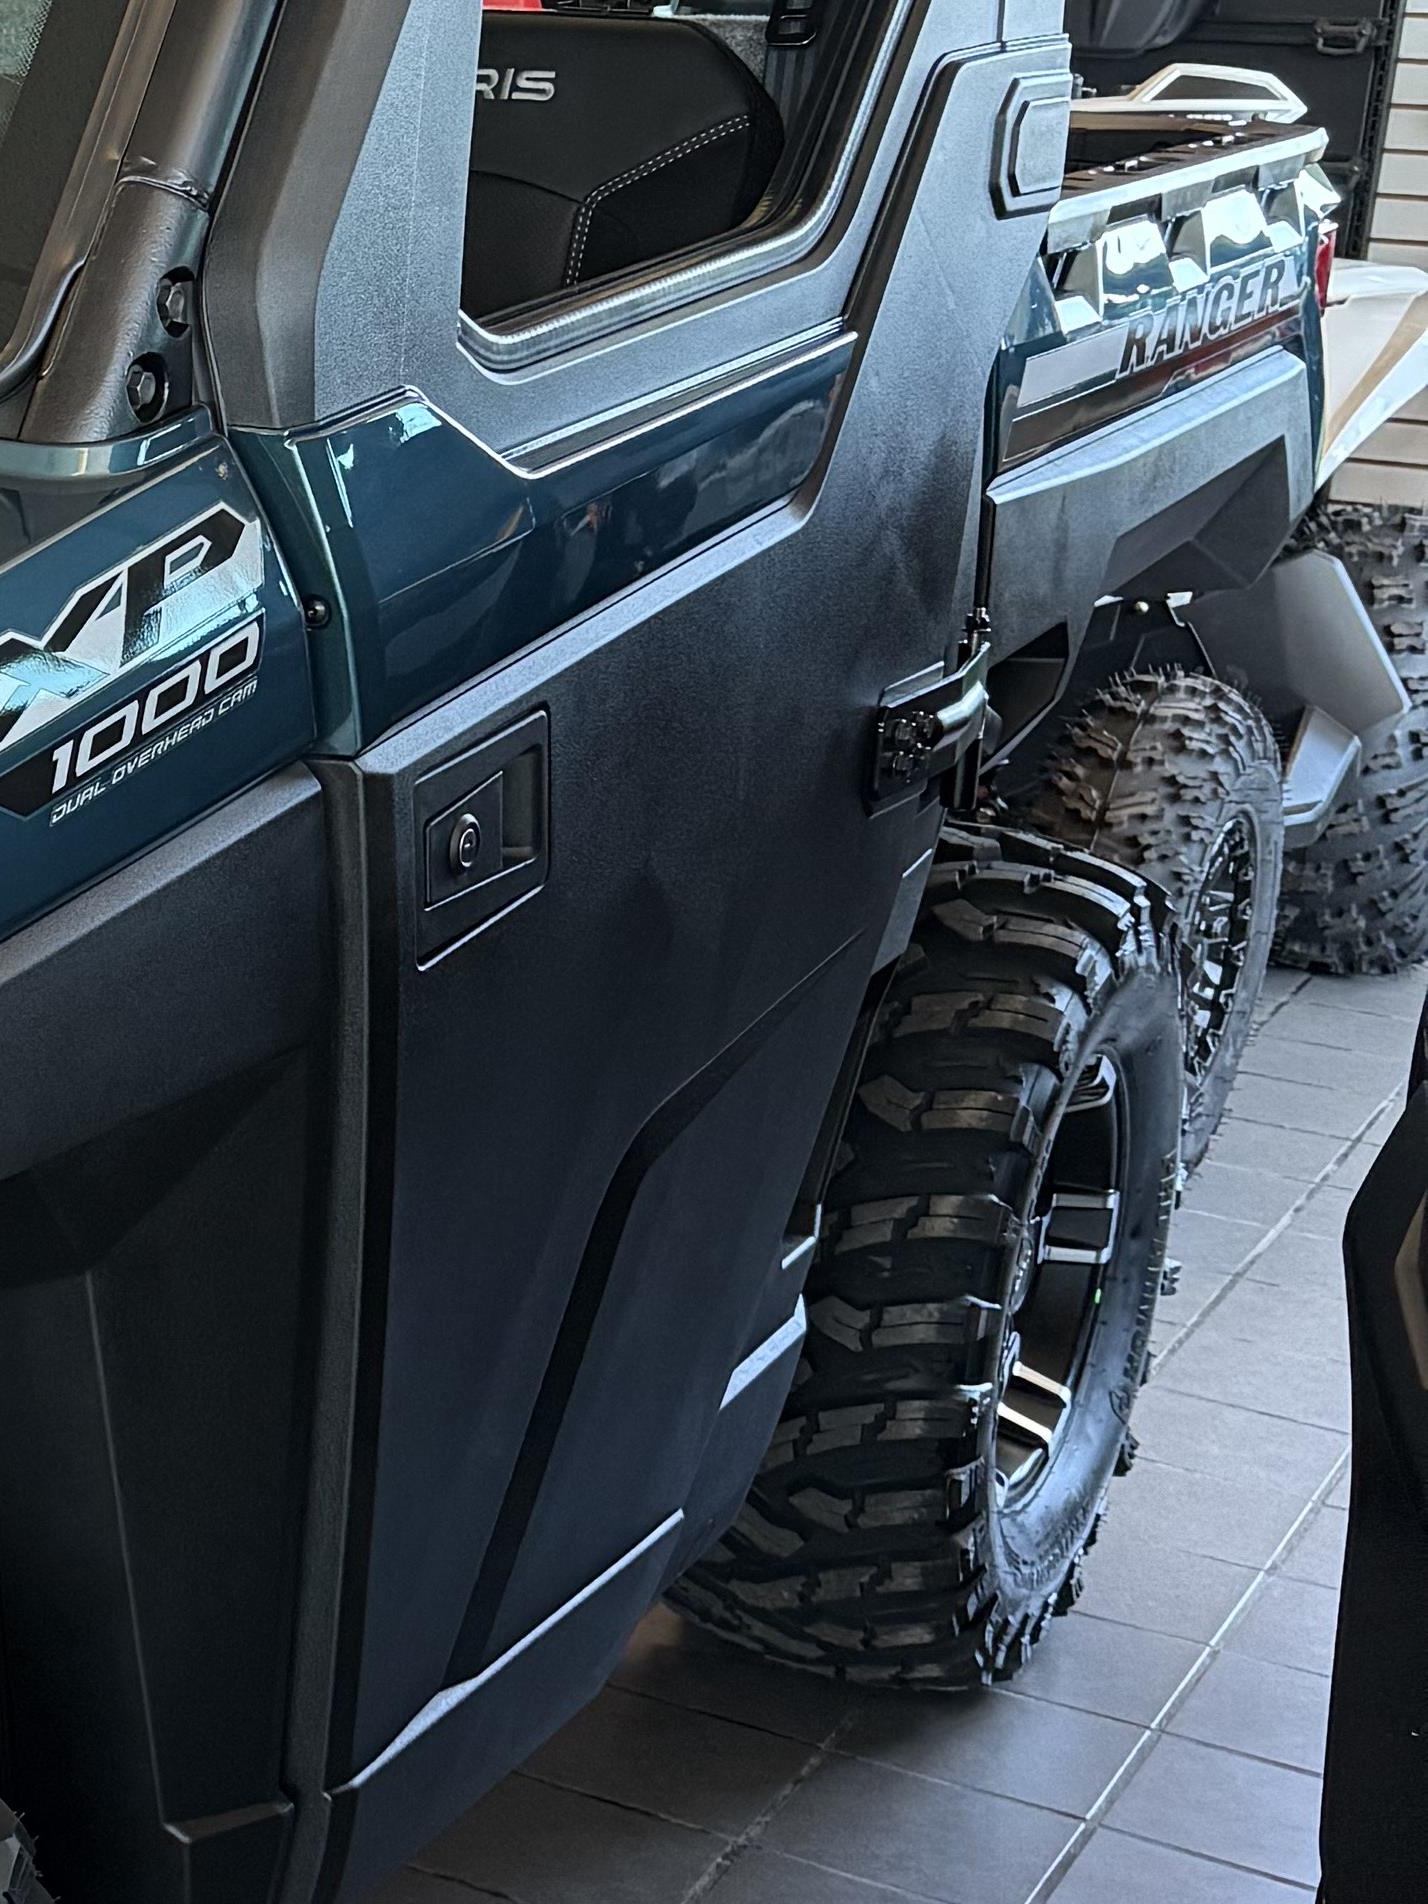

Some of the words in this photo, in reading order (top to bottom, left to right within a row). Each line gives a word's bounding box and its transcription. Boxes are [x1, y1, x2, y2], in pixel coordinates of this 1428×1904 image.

[1116, 258, 1289, 379] RANGER
[50, 780, 106, 825] DUAL
[111, 708, 215, 786] OVERHEAD
[218, 678, 258, 716] CAM
[51, 622, 260, 795] 1000
